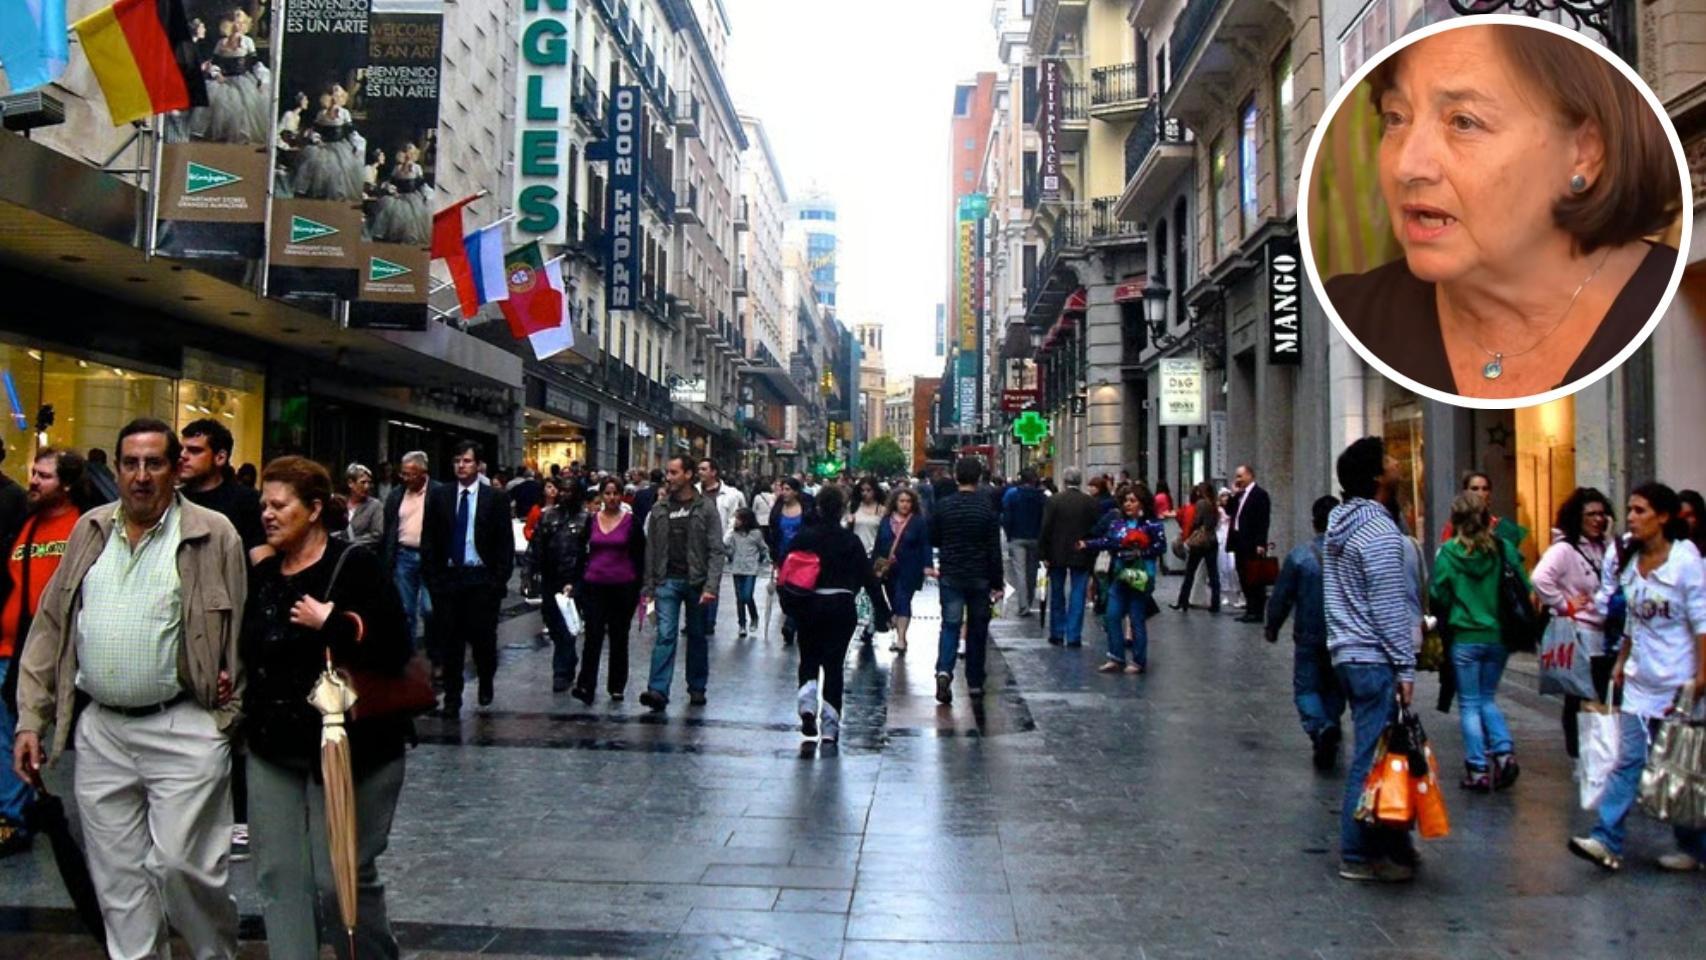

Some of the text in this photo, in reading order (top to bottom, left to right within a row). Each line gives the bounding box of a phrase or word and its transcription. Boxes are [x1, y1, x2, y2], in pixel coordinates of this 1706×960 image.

[288, 0, 368, 10] BIENVENIDO
[287, 18, 368, 33] ES UN ARTE
[370, 23, 440, 37] WELCOME
[384, 45, 408, 58] AN
[410, 46, 436, 59] ART
[368, 66, 437, 78] BIENVENIDO
[367, 85, 437, 98] ES UN ARTE
[517, 0, 568, 233] GLES
[612, 89, 634, 307] SPORT 2000
[1273, 254, 1298, 353] MANGO
